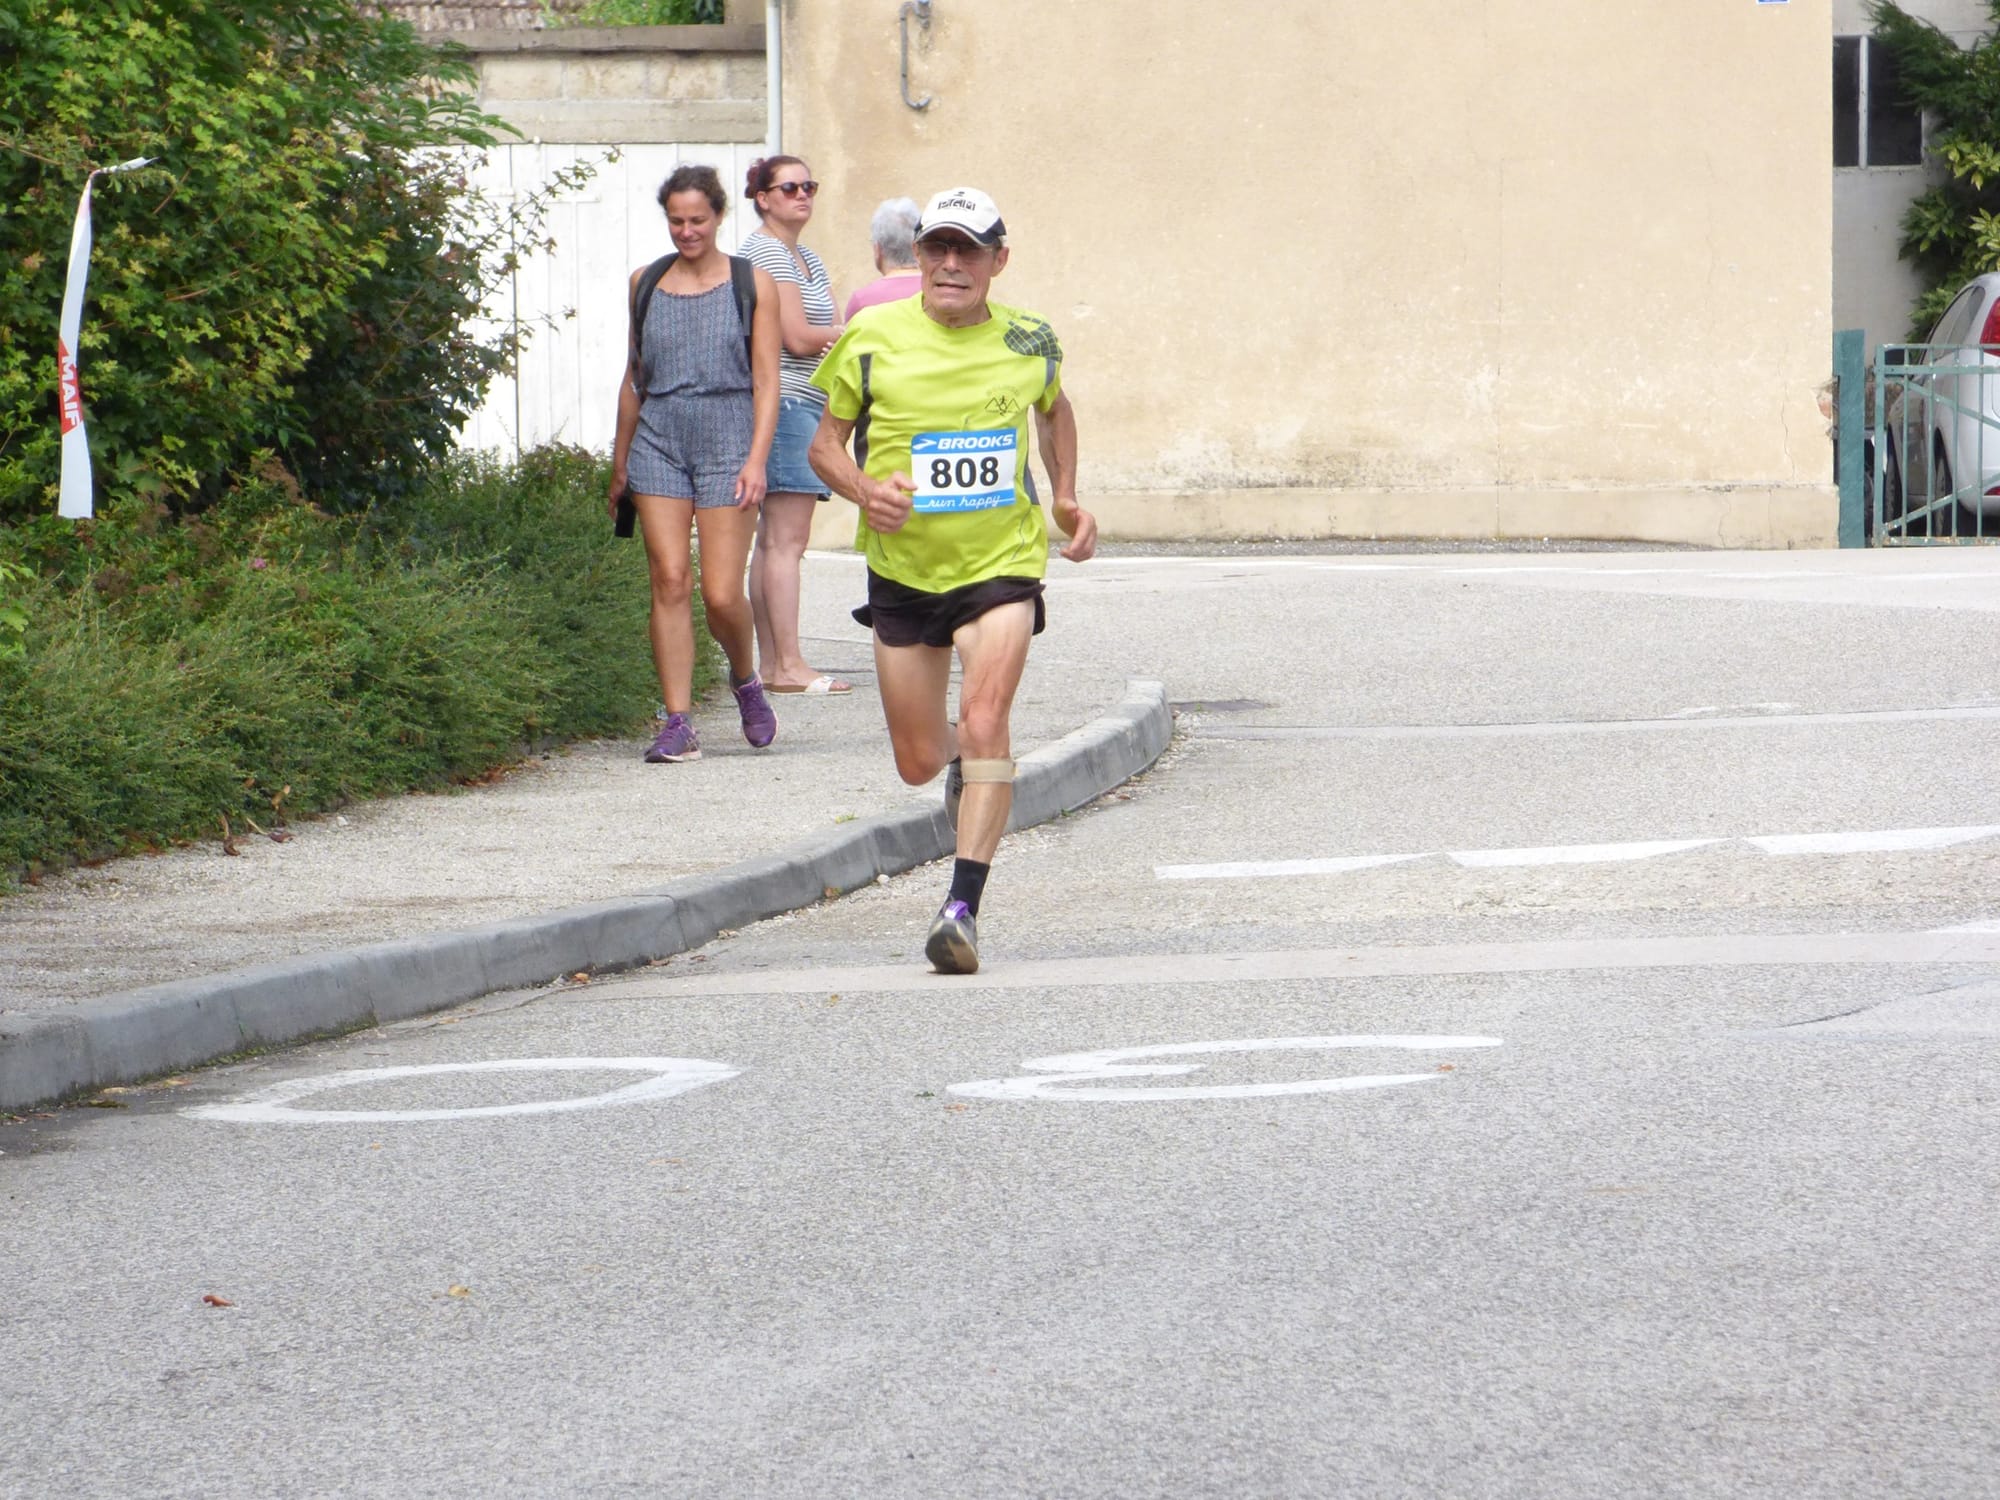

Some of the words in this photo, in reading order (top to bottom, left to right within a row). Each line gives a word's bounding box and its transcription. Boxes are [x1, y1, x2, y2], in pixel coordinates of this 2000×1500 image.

[60, 355, 80, 427] MAIF
[938, 435, 1013, 449] BROOKS
[931, 457, 999, 488] 808
[929, 499, 956, 509] run
[959, 497, 1001, 509] happy
